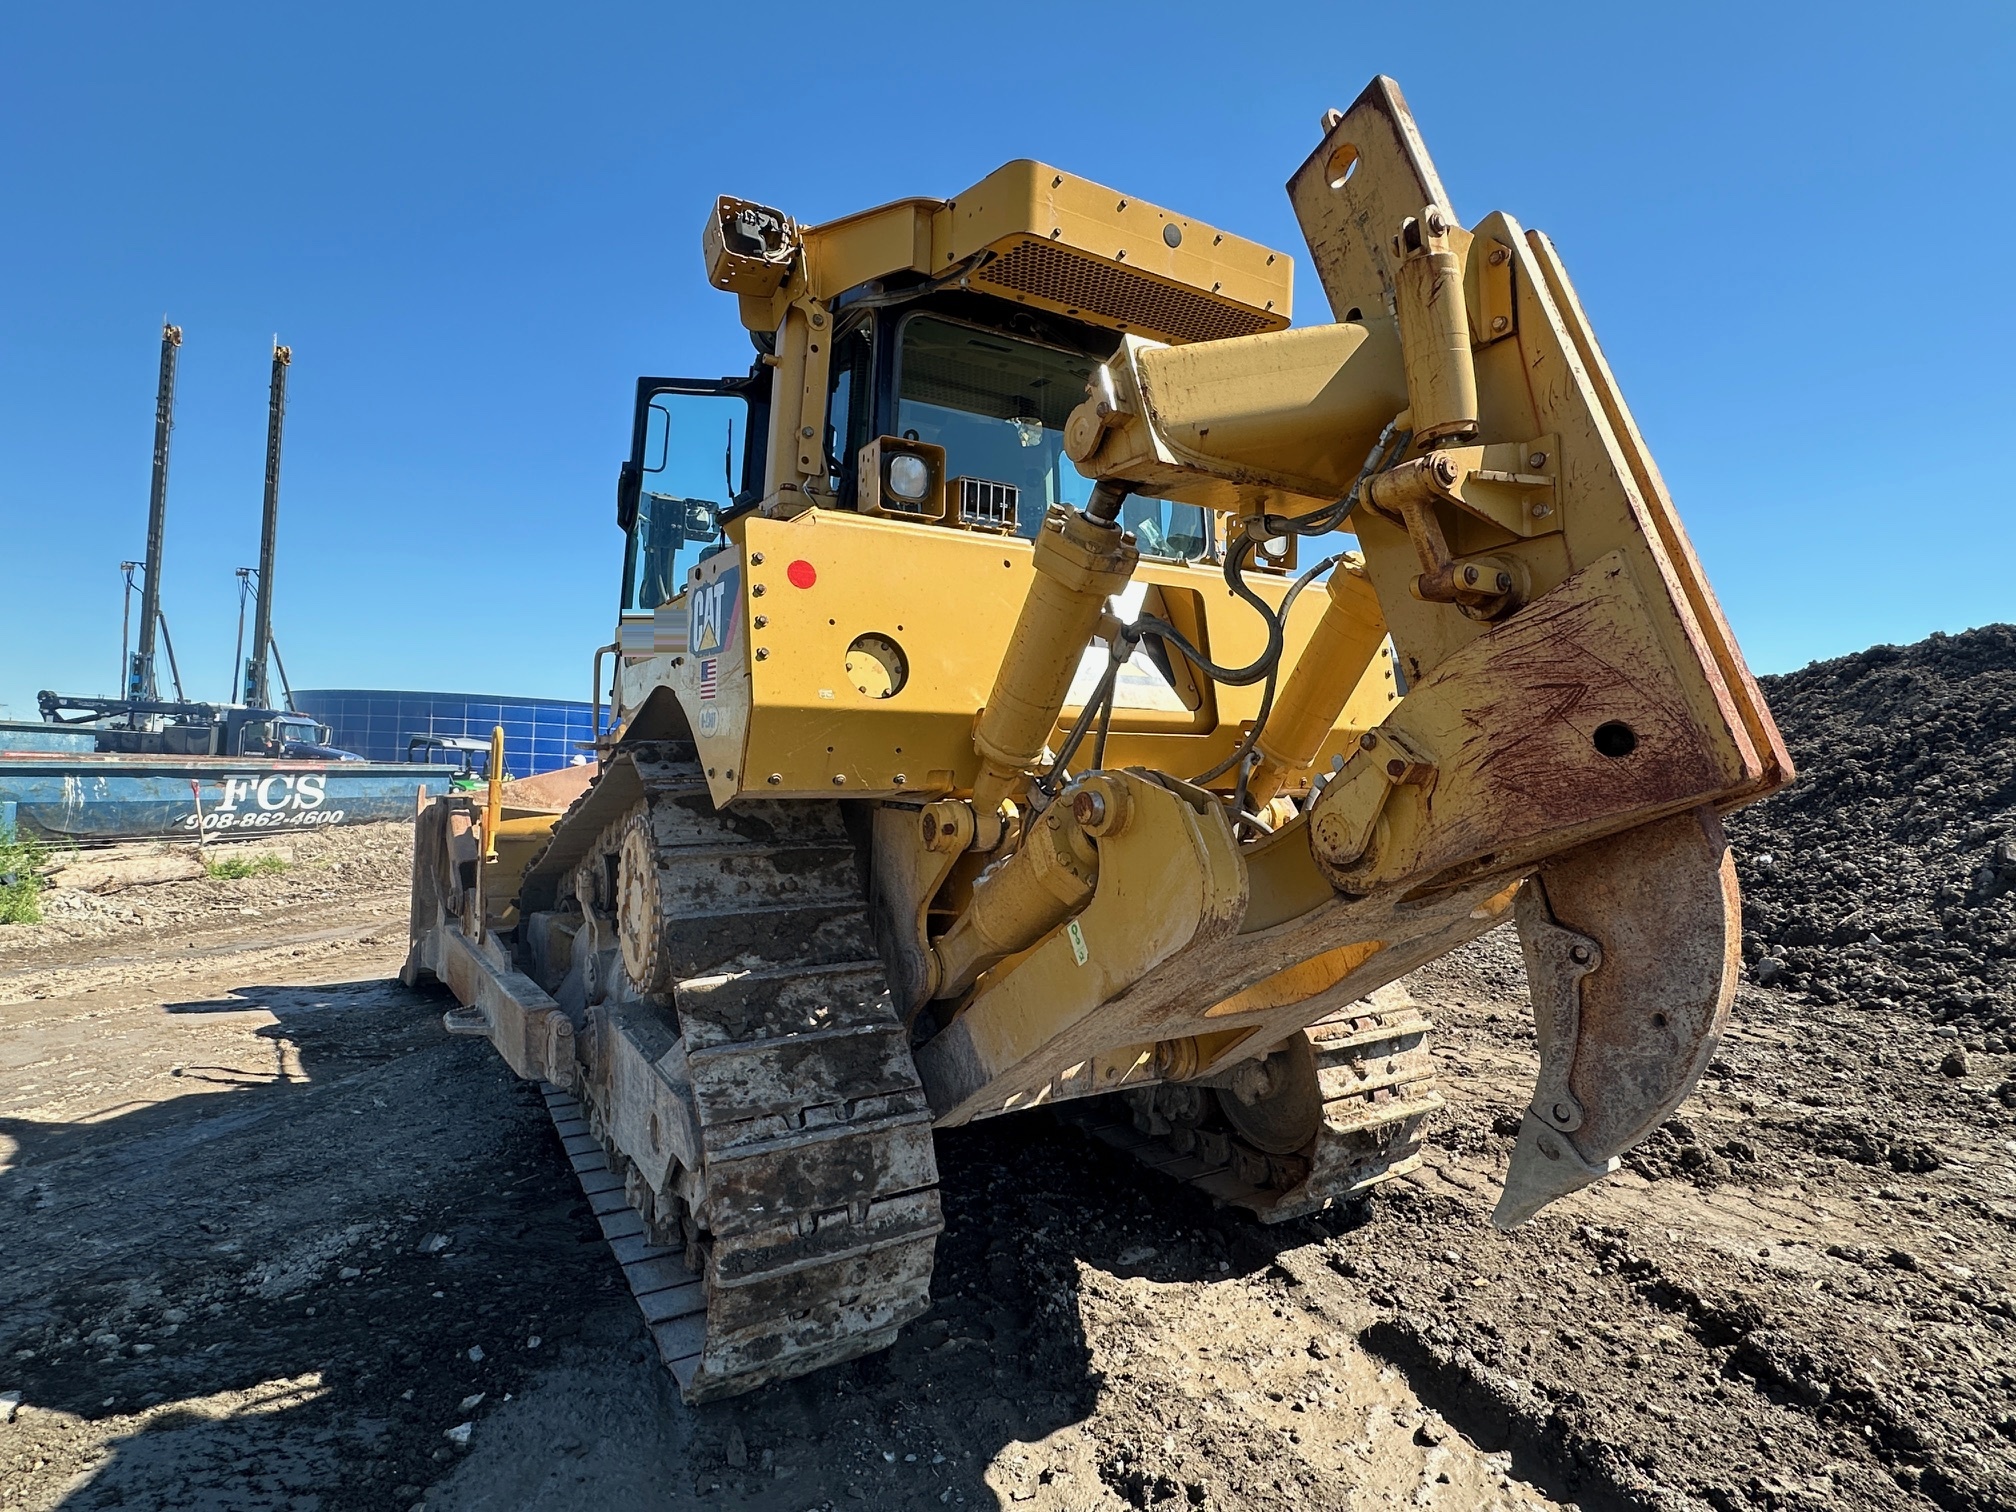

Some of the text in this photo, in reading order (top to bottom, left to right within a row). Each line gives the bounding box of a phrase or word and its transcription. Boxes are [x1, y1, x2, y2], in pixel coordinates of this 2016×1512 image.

[694, 581, 725, 652] CAT
[214, 773, 327, 812] FCS
[184, 810, 344, 830] 908-862-4600
